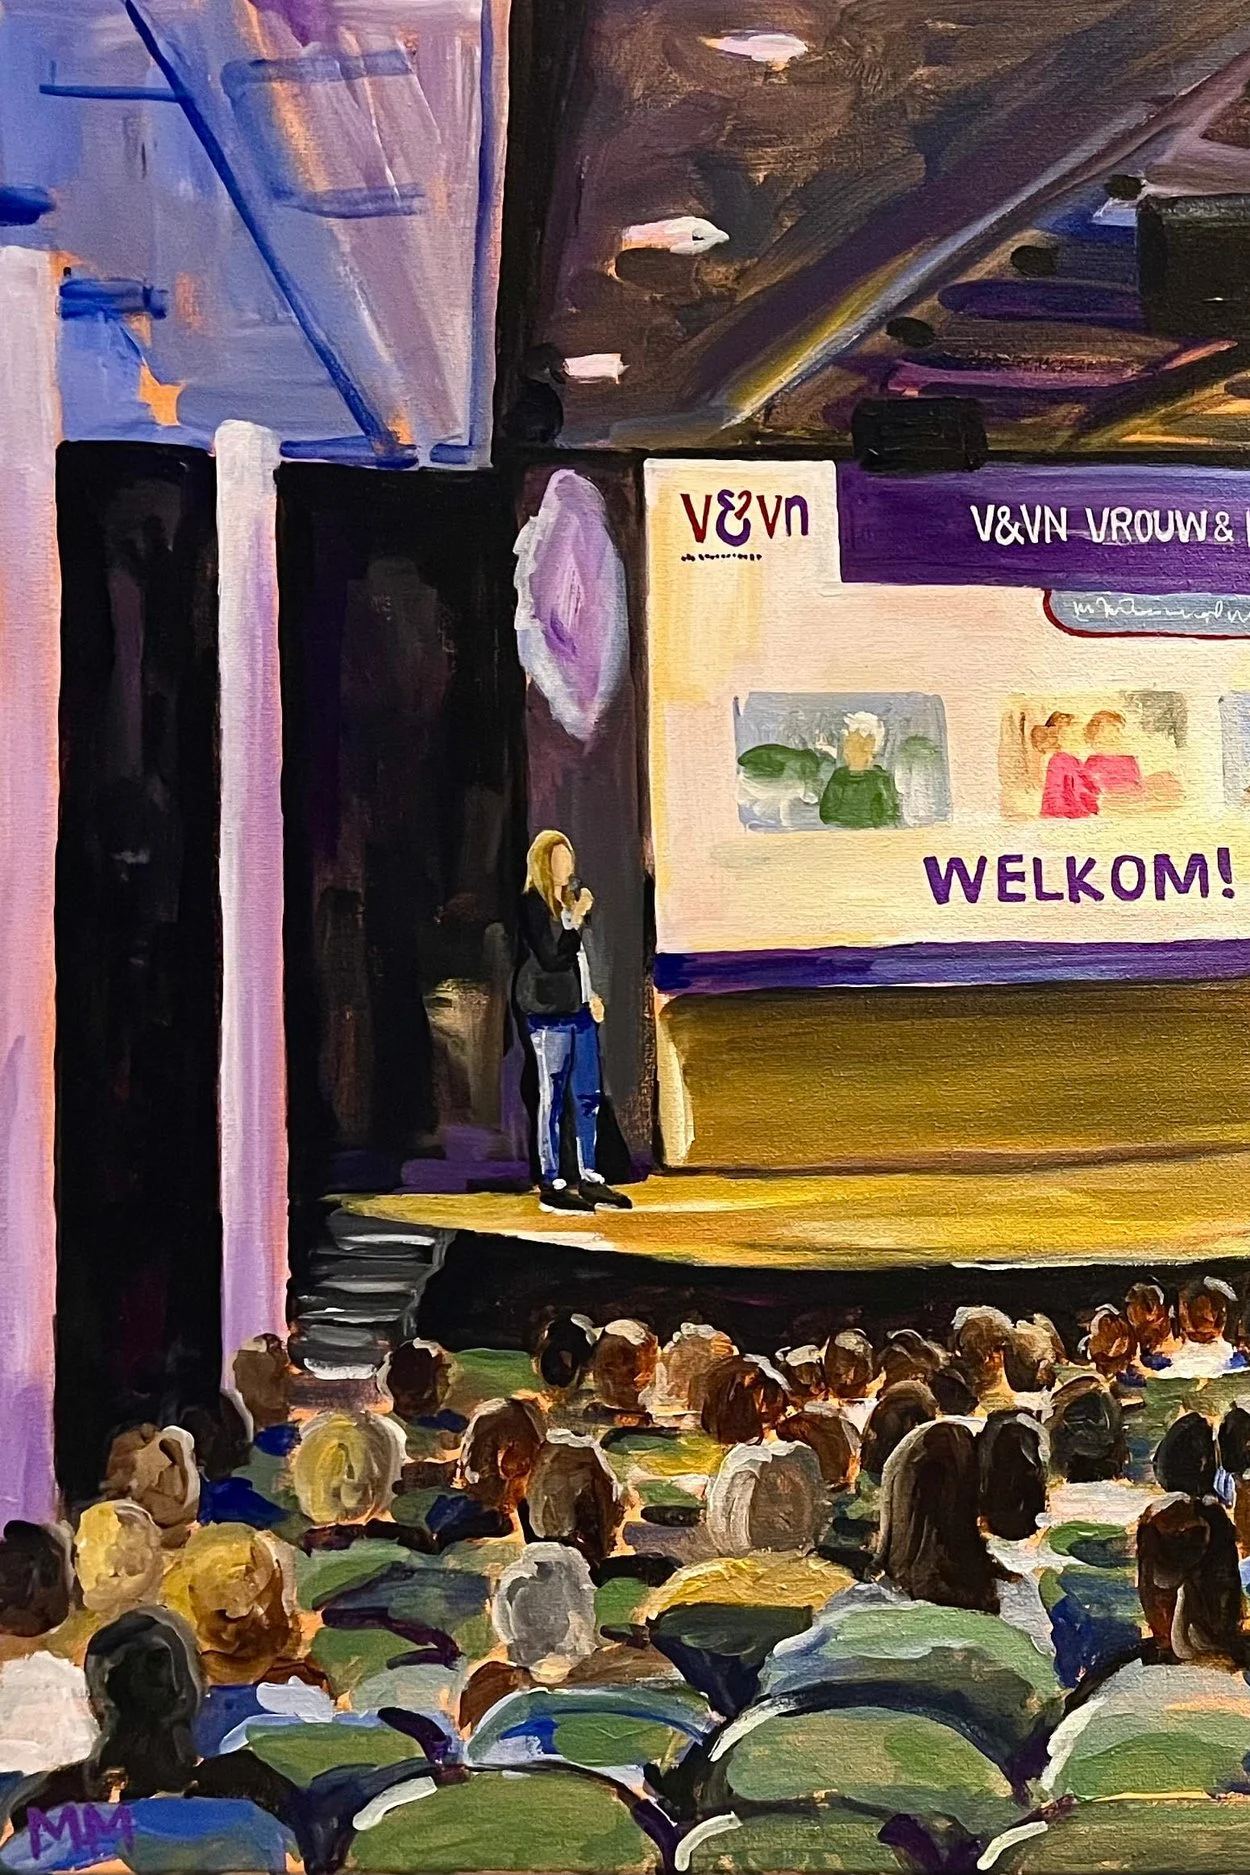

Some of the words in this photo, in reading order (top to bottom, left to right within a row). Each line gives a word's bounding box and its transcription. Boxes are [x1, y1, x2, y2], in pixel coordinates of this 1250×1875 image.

[970, 504, 1068, 546] V&VN
[1085, 506, 1208, 545] VROUW
[1214, 510, 1235, 543] &
[923, 847, 1236, 904] WELKOM!
[27, 1801, 136, 1861] MM
